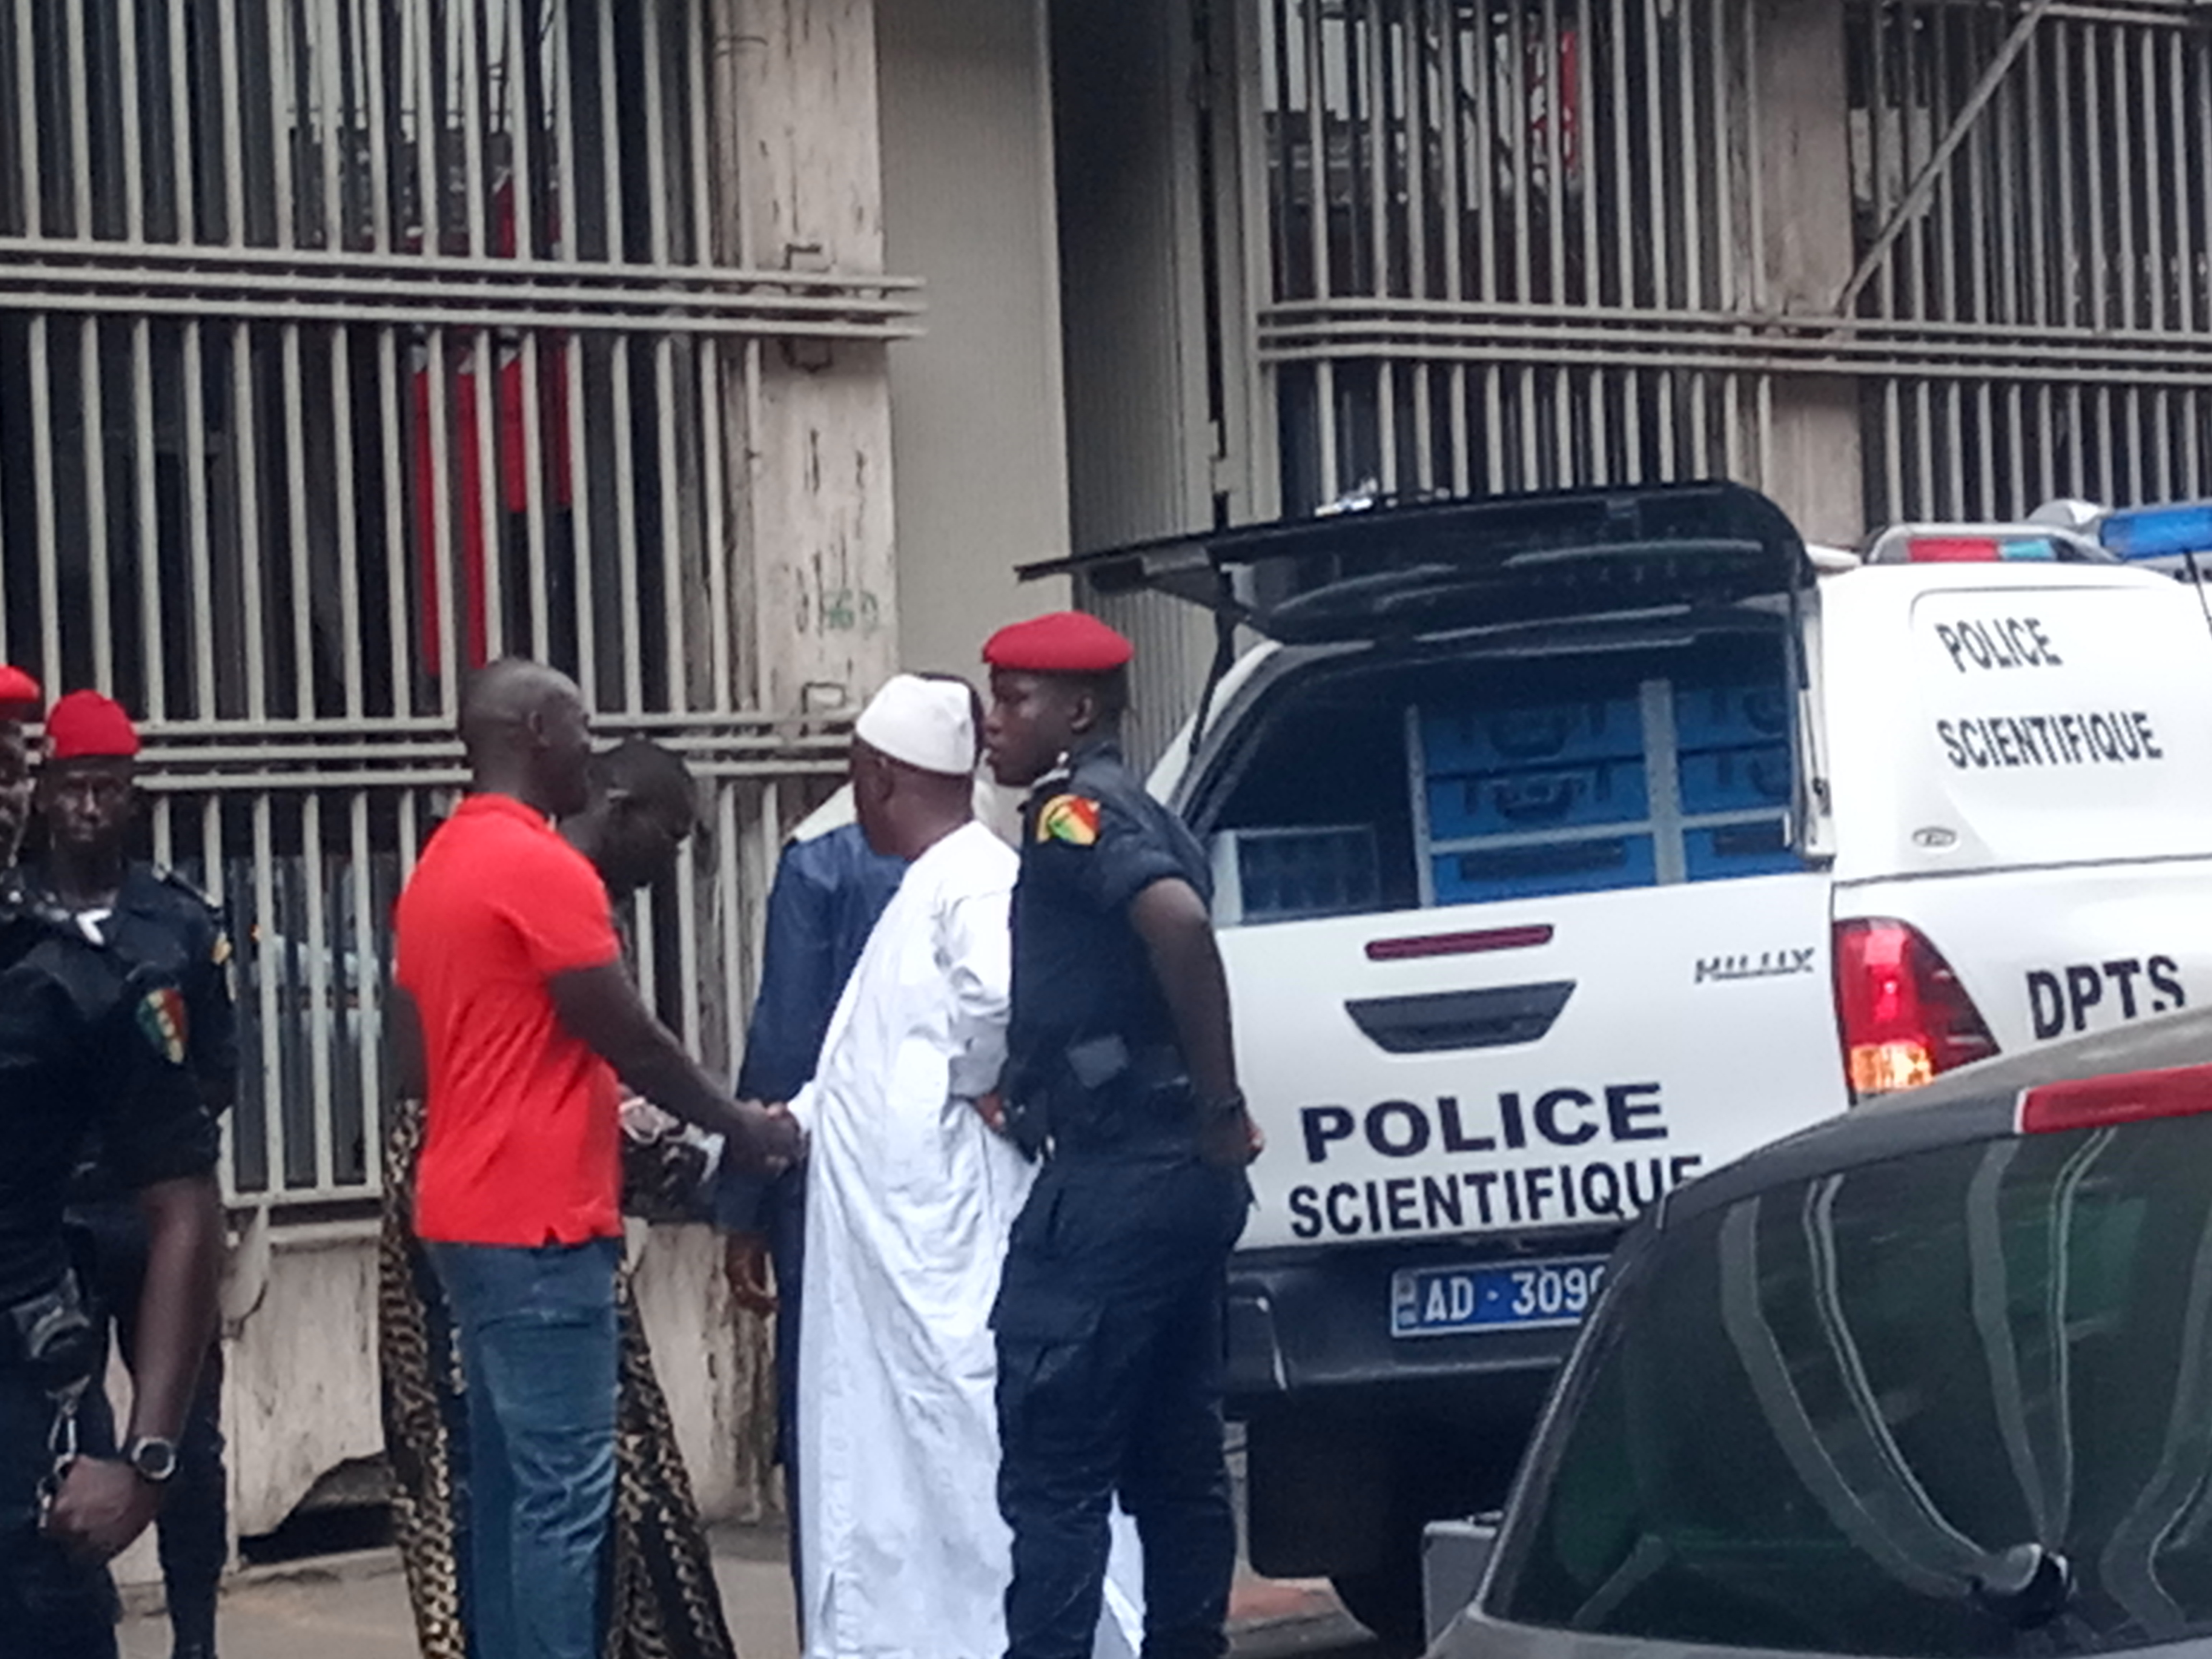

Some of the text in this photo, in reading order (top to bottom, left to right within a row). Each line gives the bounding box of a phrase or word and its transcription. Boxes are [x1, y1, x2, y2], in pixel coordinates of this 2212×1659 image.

[1935, 617, 2063, 673] POLICE
[1936, 711, 2163, 769] SCIENTIFIQUE
[2026, 954, 2185, 1040] DPTS
[1300, 1082, 1668, 1164] POLICE
[1424, 1277, 1474, 1322] AD
